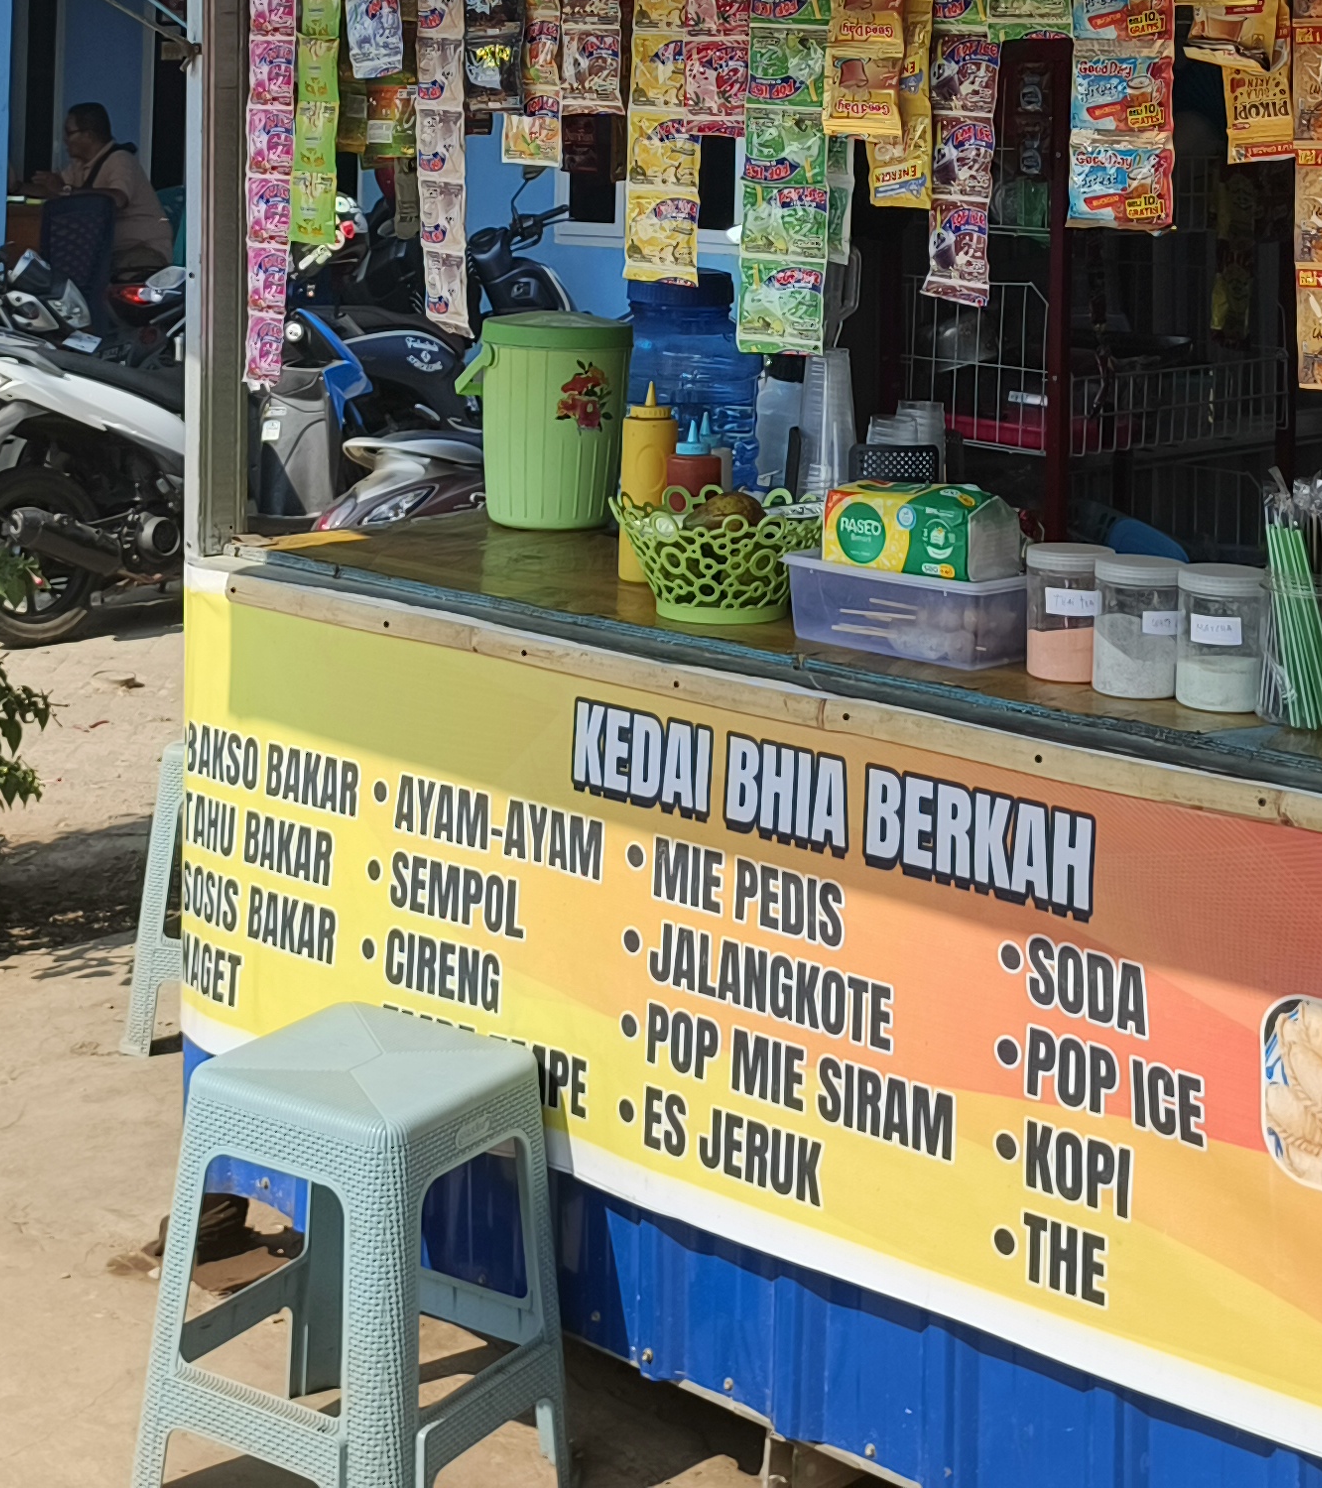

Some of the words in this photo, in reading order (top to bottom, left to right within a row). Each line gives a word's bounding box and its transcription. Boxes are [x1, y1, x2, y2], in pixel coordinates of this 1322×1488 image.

[865, 26, 894, 39] Good
[1078, 62, 1108, 76] Good
[836, 98, 862, 114] Day
[862, 102, 891, 116] Good
[839, 516, 882, 536] PASEO
[266, 742, 359, 817] BAKAR
[572, 698, 713, 821] KEDAI
[725, 731, 847, 858] BHIA
[864, 764, 1096, 923] BERKAH
[244, 810, 333, 887] BAKAR
[394, 774, 604, 883] AYAM-AYAM
[247, 884, 337, 965] BAKAR
[388, 850, 526, 940] SEMPOL
[651, 835, 724, 914] MIE
[733, 857, 845, 948] PEDIS
[384, 926, 502, 1014] CIRENG
[648, 922, 894, 1053] JALANGKOTE
[1024, 934, 1149, 1038] SODA
[645, 1001, 720, 1082] POP
[730, 1028, 806, 1116] MIE
[816, 1054, 956, 1162] SIRAM
[1024, 1026, 1118, 1116] POP
[1130, 1057, 1206, 1150] ICE
[643, 1085, 688, 1158] ES
[699, 1105, 824, 1209] JERUK
[1024, 1119, 1132, 1220] KOPI
[1022, 1212, 1108, 1308] THE
